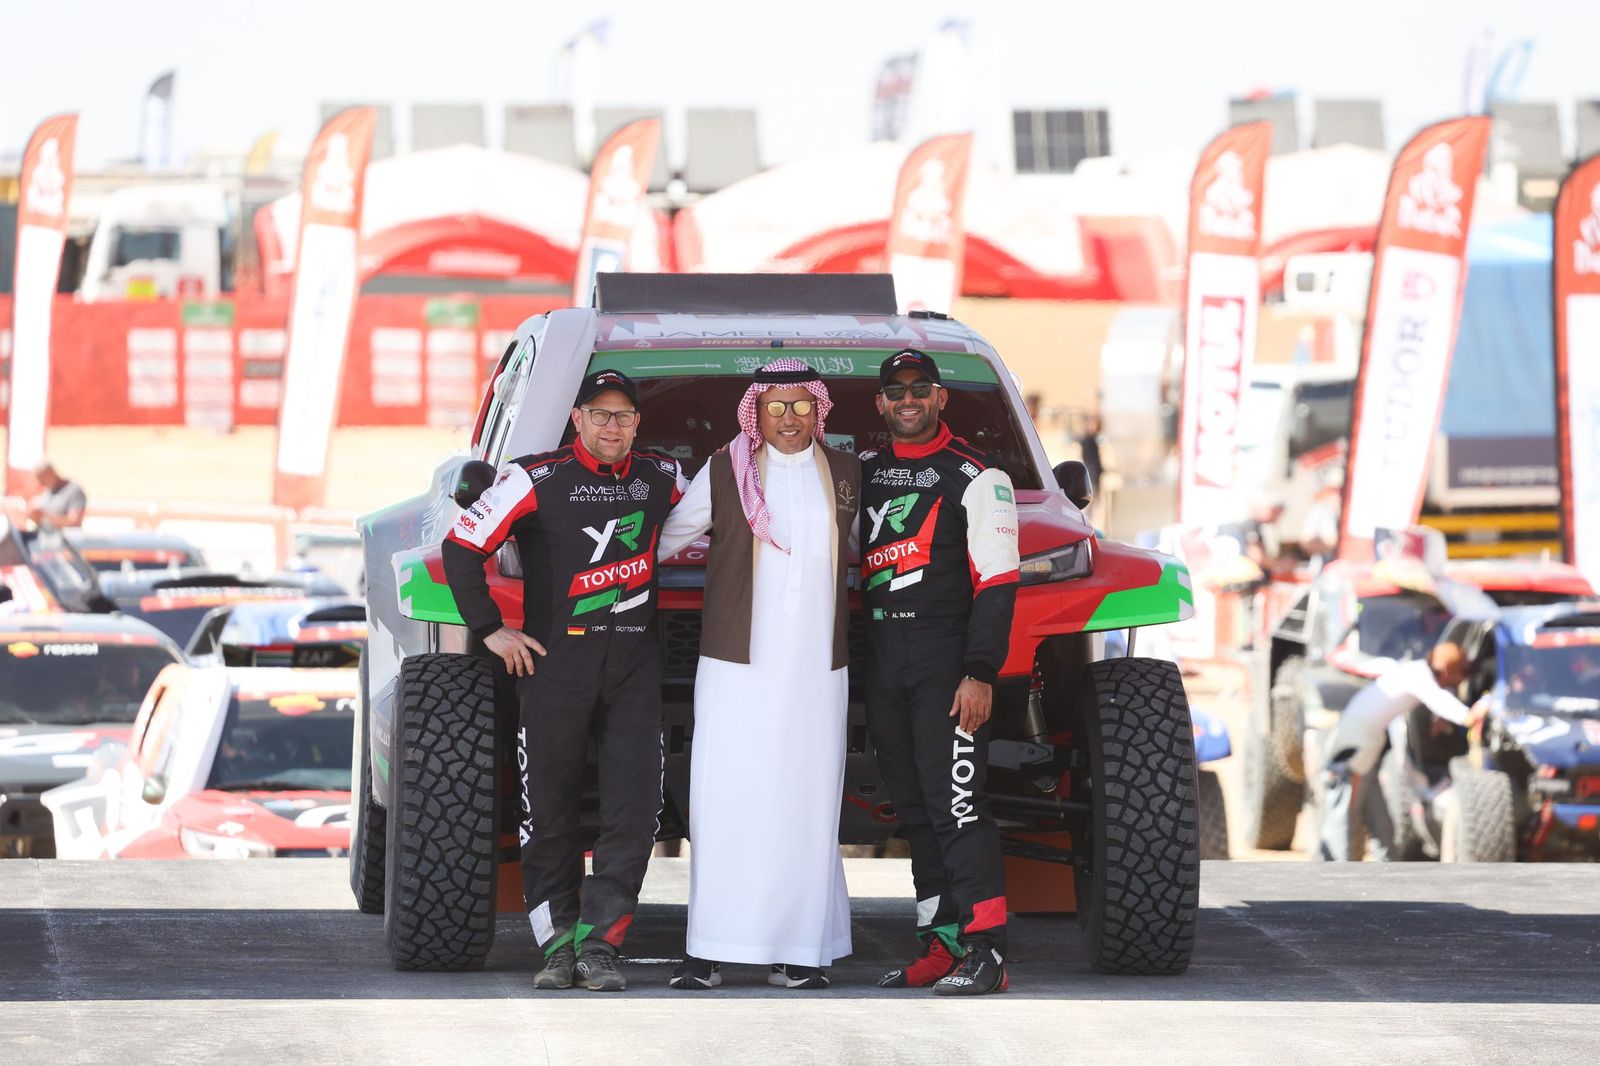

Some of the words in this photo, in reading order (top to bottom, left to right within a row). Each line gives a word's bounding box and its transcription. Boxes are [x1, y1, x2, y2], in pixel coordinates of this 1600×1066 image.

[531, 466, 549, 477] OMP
[961, 463, 980, 478] OMP
[569, 485, 628, 495] JAMEEL
[866, 541, 919, 568] TOYOTA
[579, 558, 648, 588] TOYOTA
[44, 643, 98, 657] repsol
[299, 650, 334, 662] ZAF
